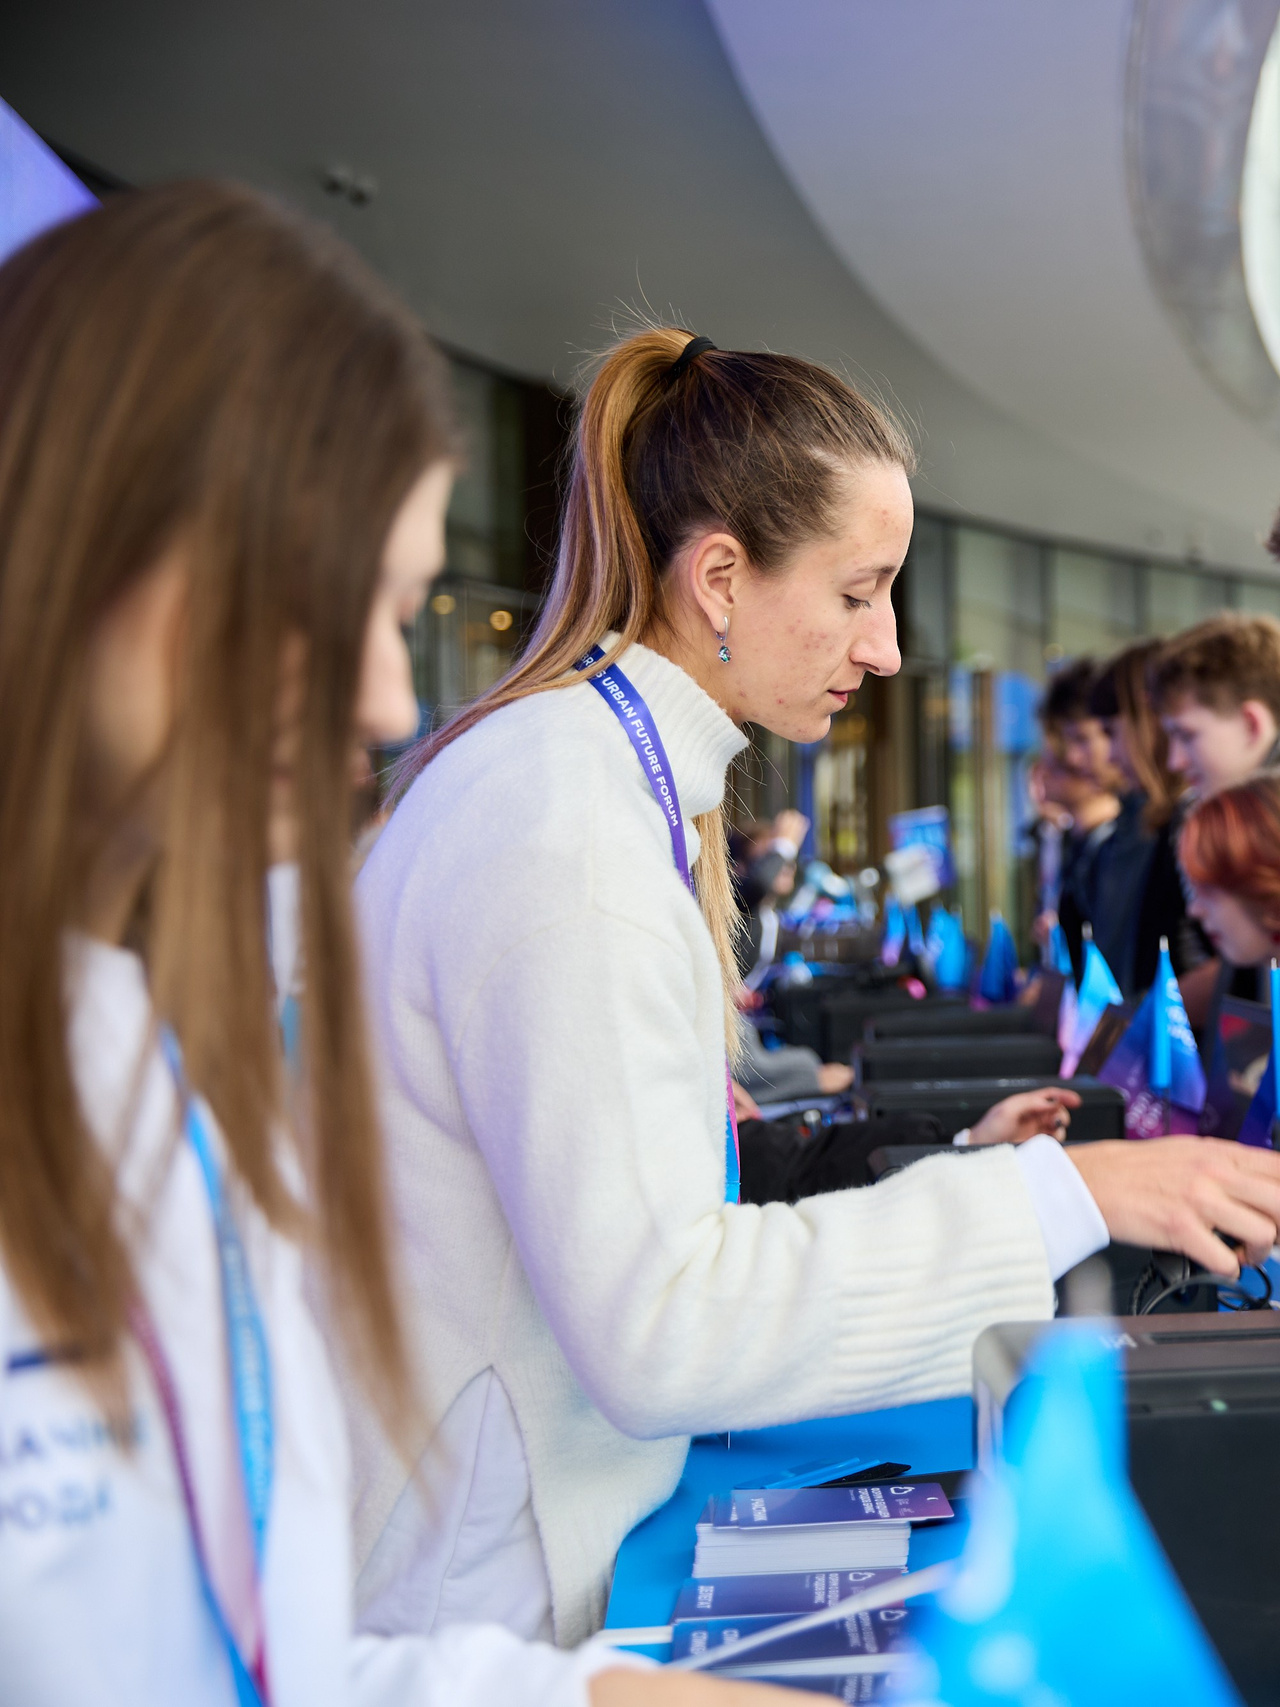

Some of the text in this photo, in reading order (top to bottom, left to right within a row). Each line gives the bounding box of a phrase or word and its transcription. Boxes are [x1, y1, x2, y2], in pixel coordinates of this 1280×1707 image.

[602, 676, 637, 718] URBAN
[631, 718, 662, 774] FUTURE
[656, 776, 679, 827] FORUM
